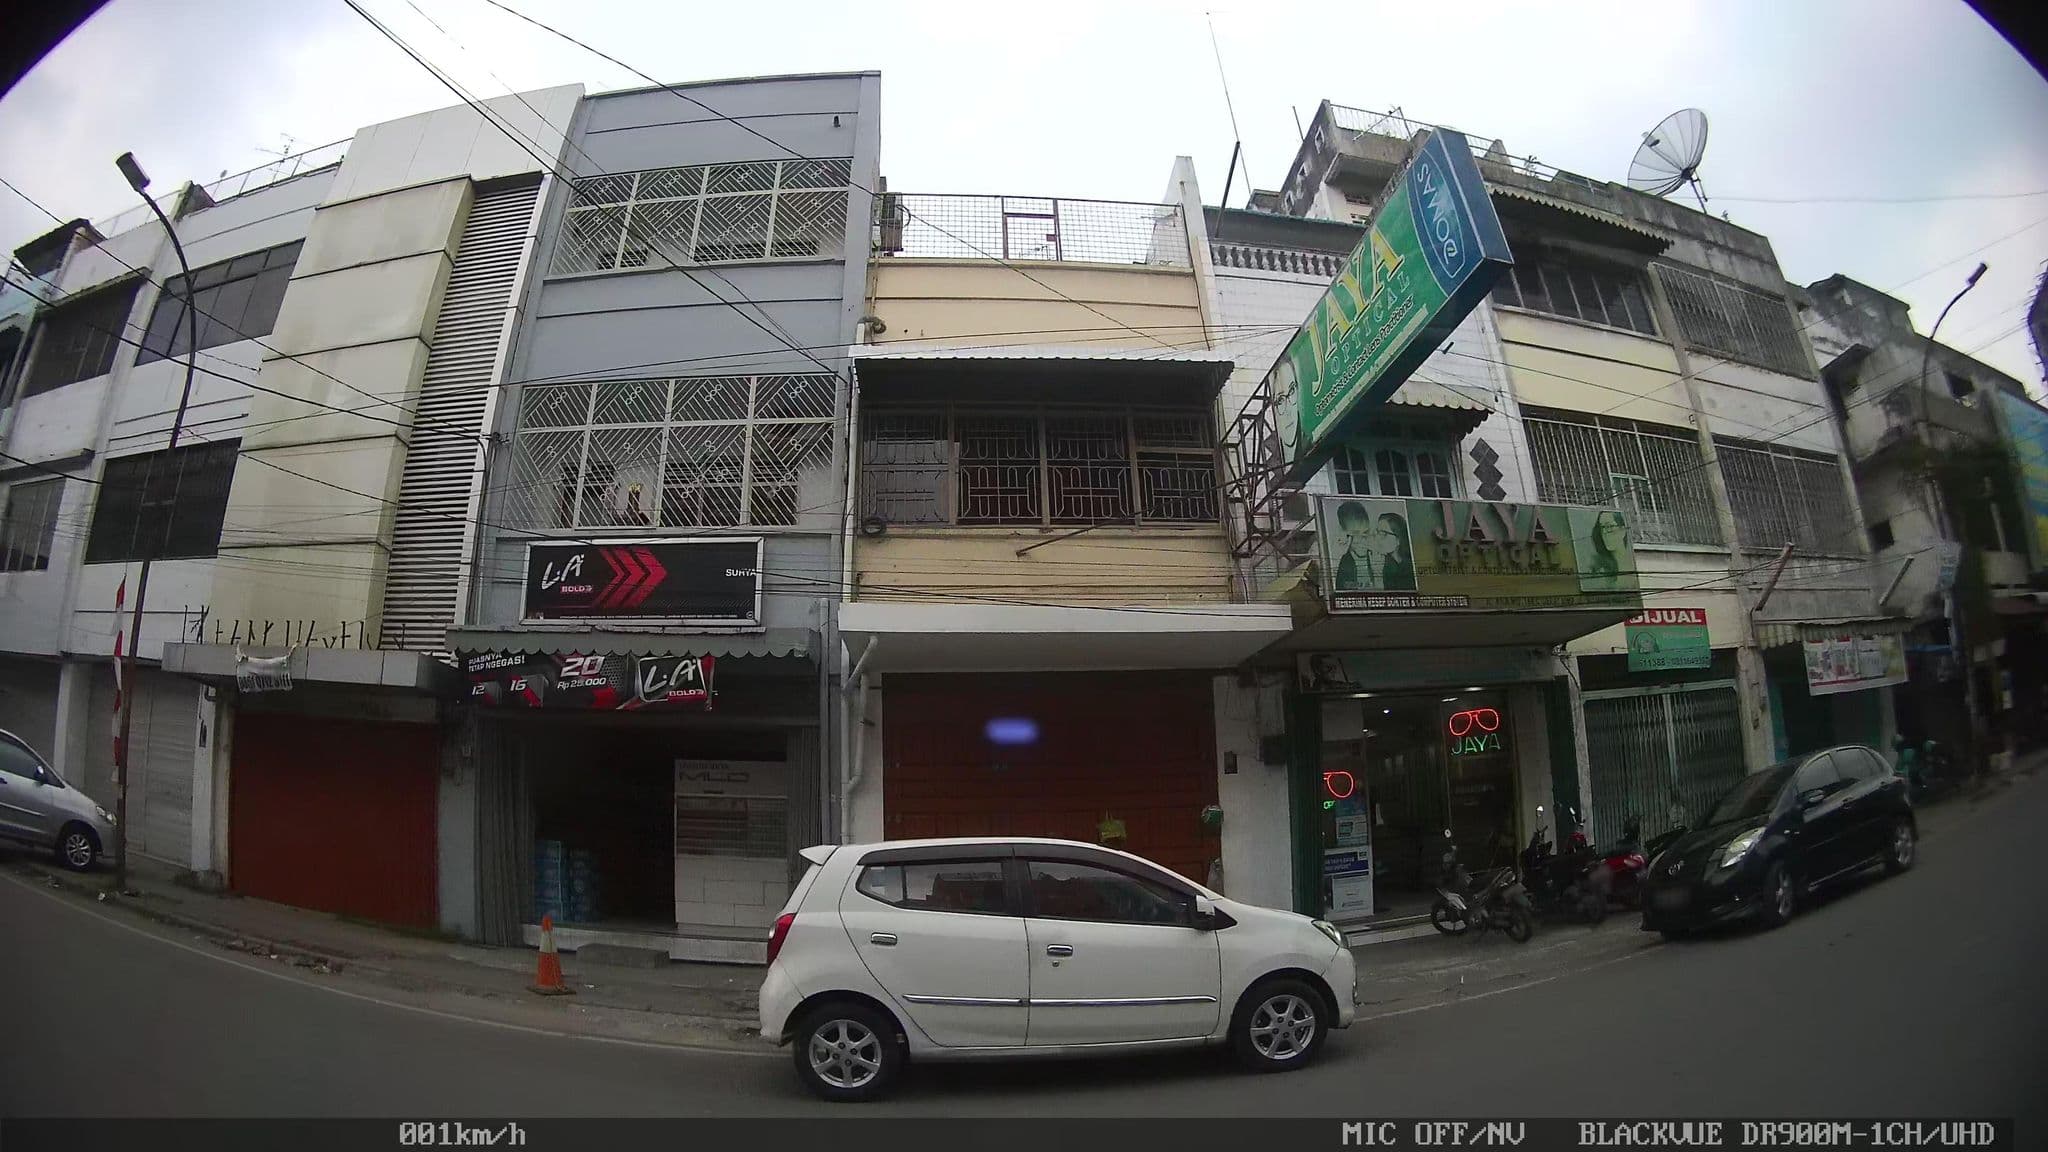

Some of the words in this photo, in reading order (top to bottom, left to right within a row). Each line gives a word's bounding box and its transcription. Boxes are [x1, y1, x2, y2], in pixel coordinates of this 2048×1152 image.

[1305, 227, 1404, 396] JAYA
[1330, 270, 1410, 376] OPTICAL
[1434, 500, 1560, 544] JAYA
[561, 585, 586, 593] BOLD
[485, 654, 526, 669] NGEGAS!
[560, 655, 606, 678] 20
[472, 684, 485, 696] 12
[510, 679, 528, 692] 16
[557, 680, 570, 690] Rp
[1451, 732, 1500, 756] JAYA
